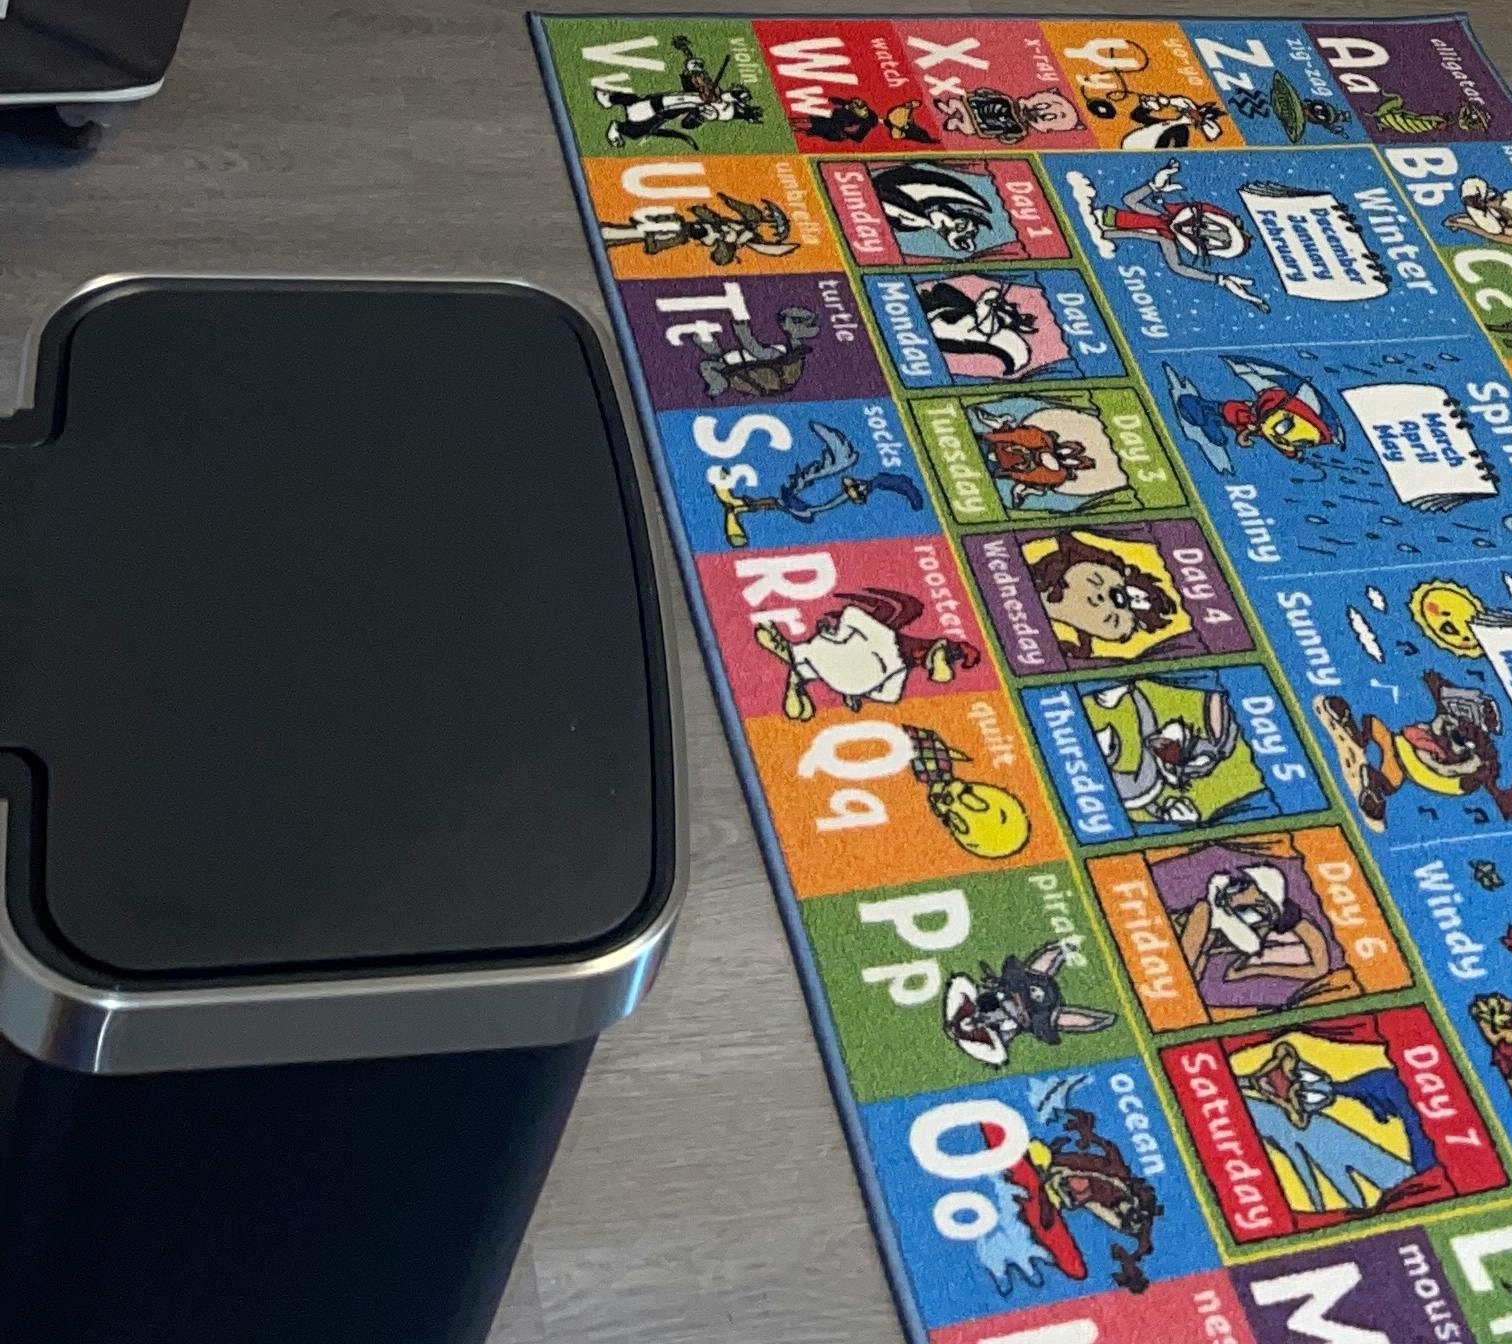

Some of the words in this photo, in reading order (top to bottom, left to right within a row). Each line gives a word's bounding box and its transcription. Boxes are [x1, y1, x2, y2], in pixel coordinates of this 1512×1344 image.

[730, 37, 759, 84] violin
[871, 38, 909, 88] watch
[1023, 38, 1059, 81] x-ray
[1162, 37, 1203, 86] yo-yo
[1286, 38, 1334, 98] zig-zag
[1430, 38, 1485, 105] alligator
[776, 162, 820, 245] umbrella
[834, 171, 885, 255] Sunday
[1005, 181, 1042, 221] Day
[1027, 224, 1053, 240] 1
[1353, 187, 1438, 296] Winter
[1256, 210, 1307, 282] February
[1287, 215, 1334, 280] January
[1309, 208, 1366, 285] December
[818, 279, 855, 342] turtle
[876, 281, 932, 377] Monday
[1055, 292, 1094, 336] Day
[1079, 341, 1108, 355] 2
[1119, 264, 1169, 340] Snowy
[863, 404, 903, 468] socks
[928, 405, 986, 513] Tuesday
[1112, 414, 1150, 465] Day
[1138, 469, 1168, 484] 3
[1372, 424, 1406, 463] May
[1399, 420, 1440, 463] April
[1422, 412, 1467, 468] March
[1225, 483, 1281, 563] Rainy
[913, 544, 966, 640] rooster
[982, 539, 1045, 666] Wednesday
[1172, 548, 1215, 601] Day
[1203, 608, 1234, 623] 4
[1276, 591, 1342, 688] Sunny
[967, 701, 1017, 768] quilt
[1040, 690, 1113, 834] Thursday
[1242, 696, 1286, 755] Day
[1272, 764, 1306, 782] 5
[1028, 873, 1089, 969] pirate
[1112, 879, 1177, 1000] Friday
[1317, 861, 1366, 926] Day
[1355, 936, 1388, 960] 6
[1413, 860, 1489, 981] Windy
[1110, 1072, 1167, 1176] ocean
[1402, 1043, 1459, 1120] Day
[1445, 1125, 1484, 1149] 7
[1180, 1051, 1273, 1231] Saturday
[1398, 1243, 1463, 1344] mous
